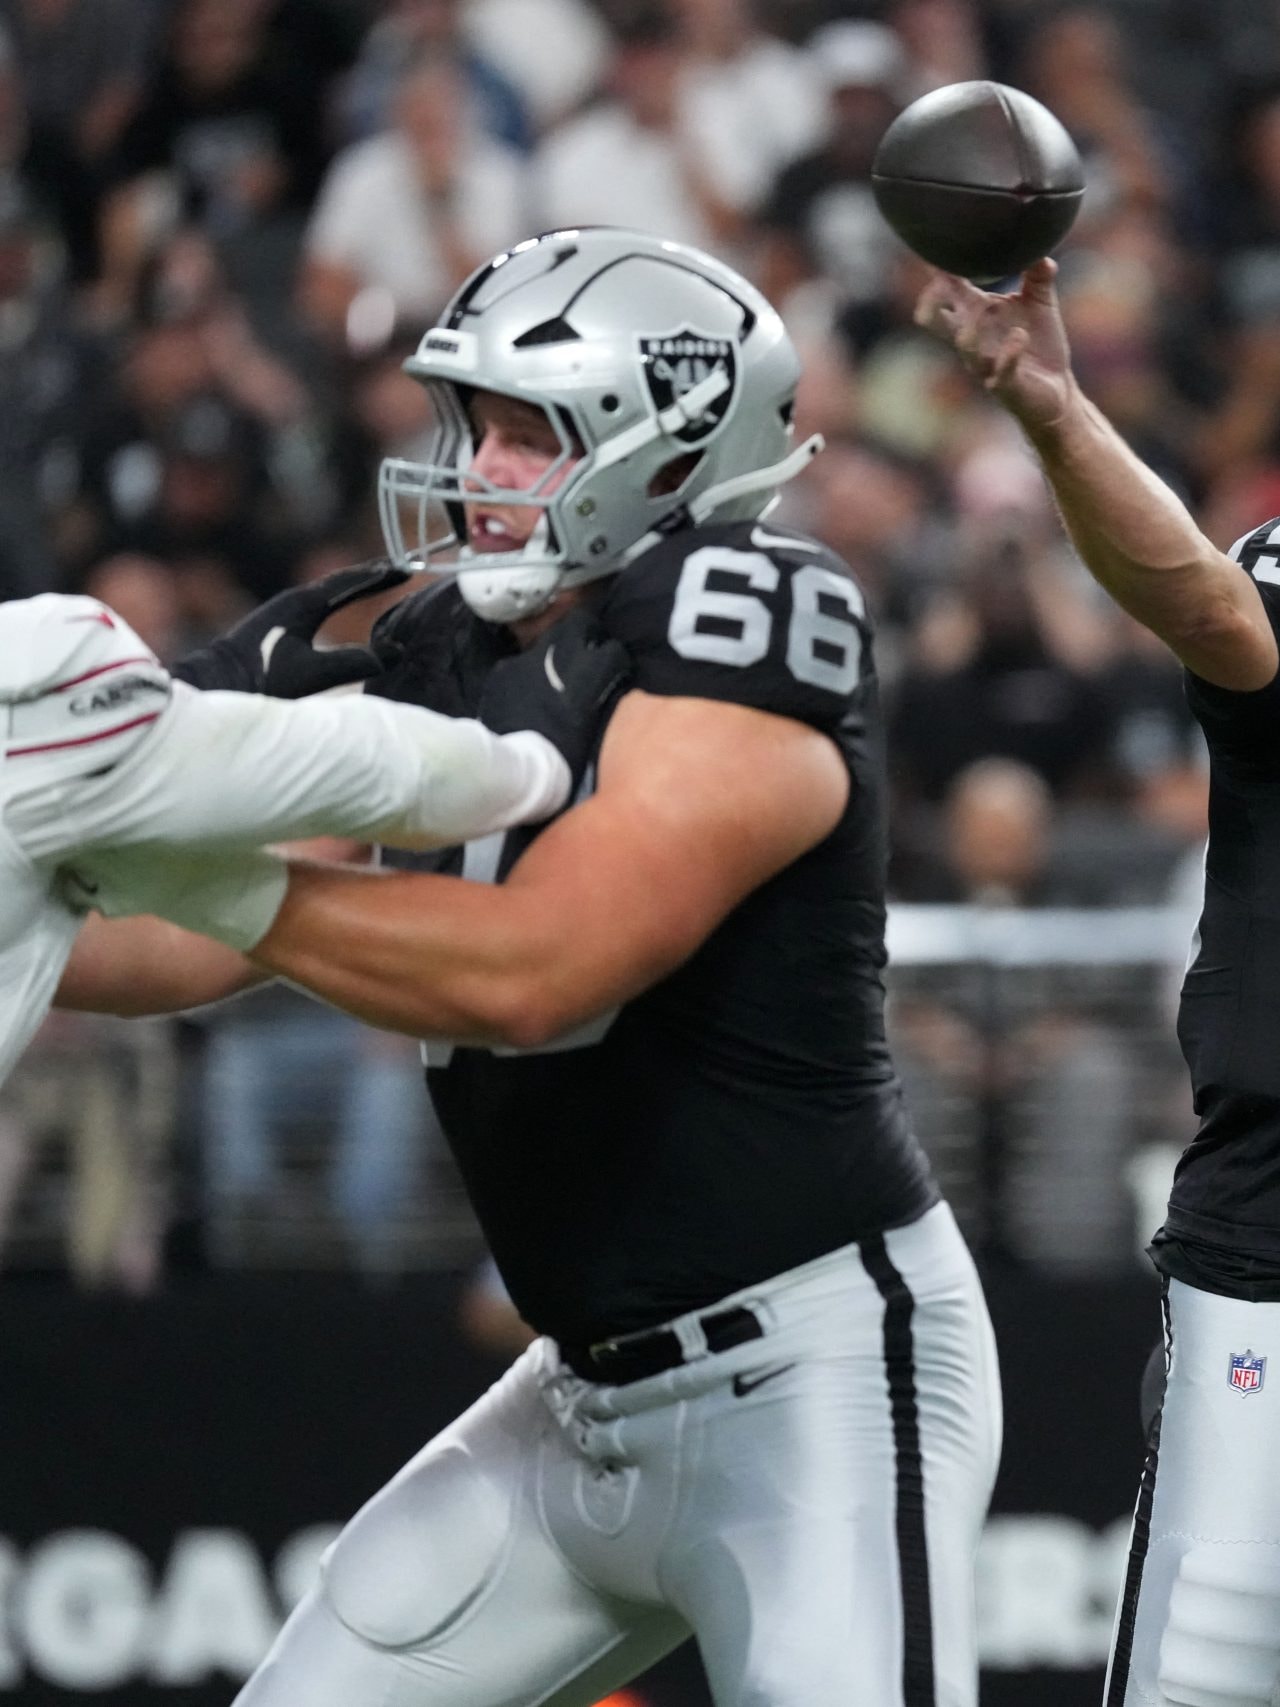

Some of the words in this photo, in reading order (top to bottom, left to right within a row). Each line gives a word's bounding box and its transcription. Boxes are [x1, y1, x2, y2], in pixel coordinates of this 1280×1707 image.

[646, 340, 730, 357] RAIDERS
[667, 545, 866, 696] 66
[1233, 1369, 1258, 1388] NFL
